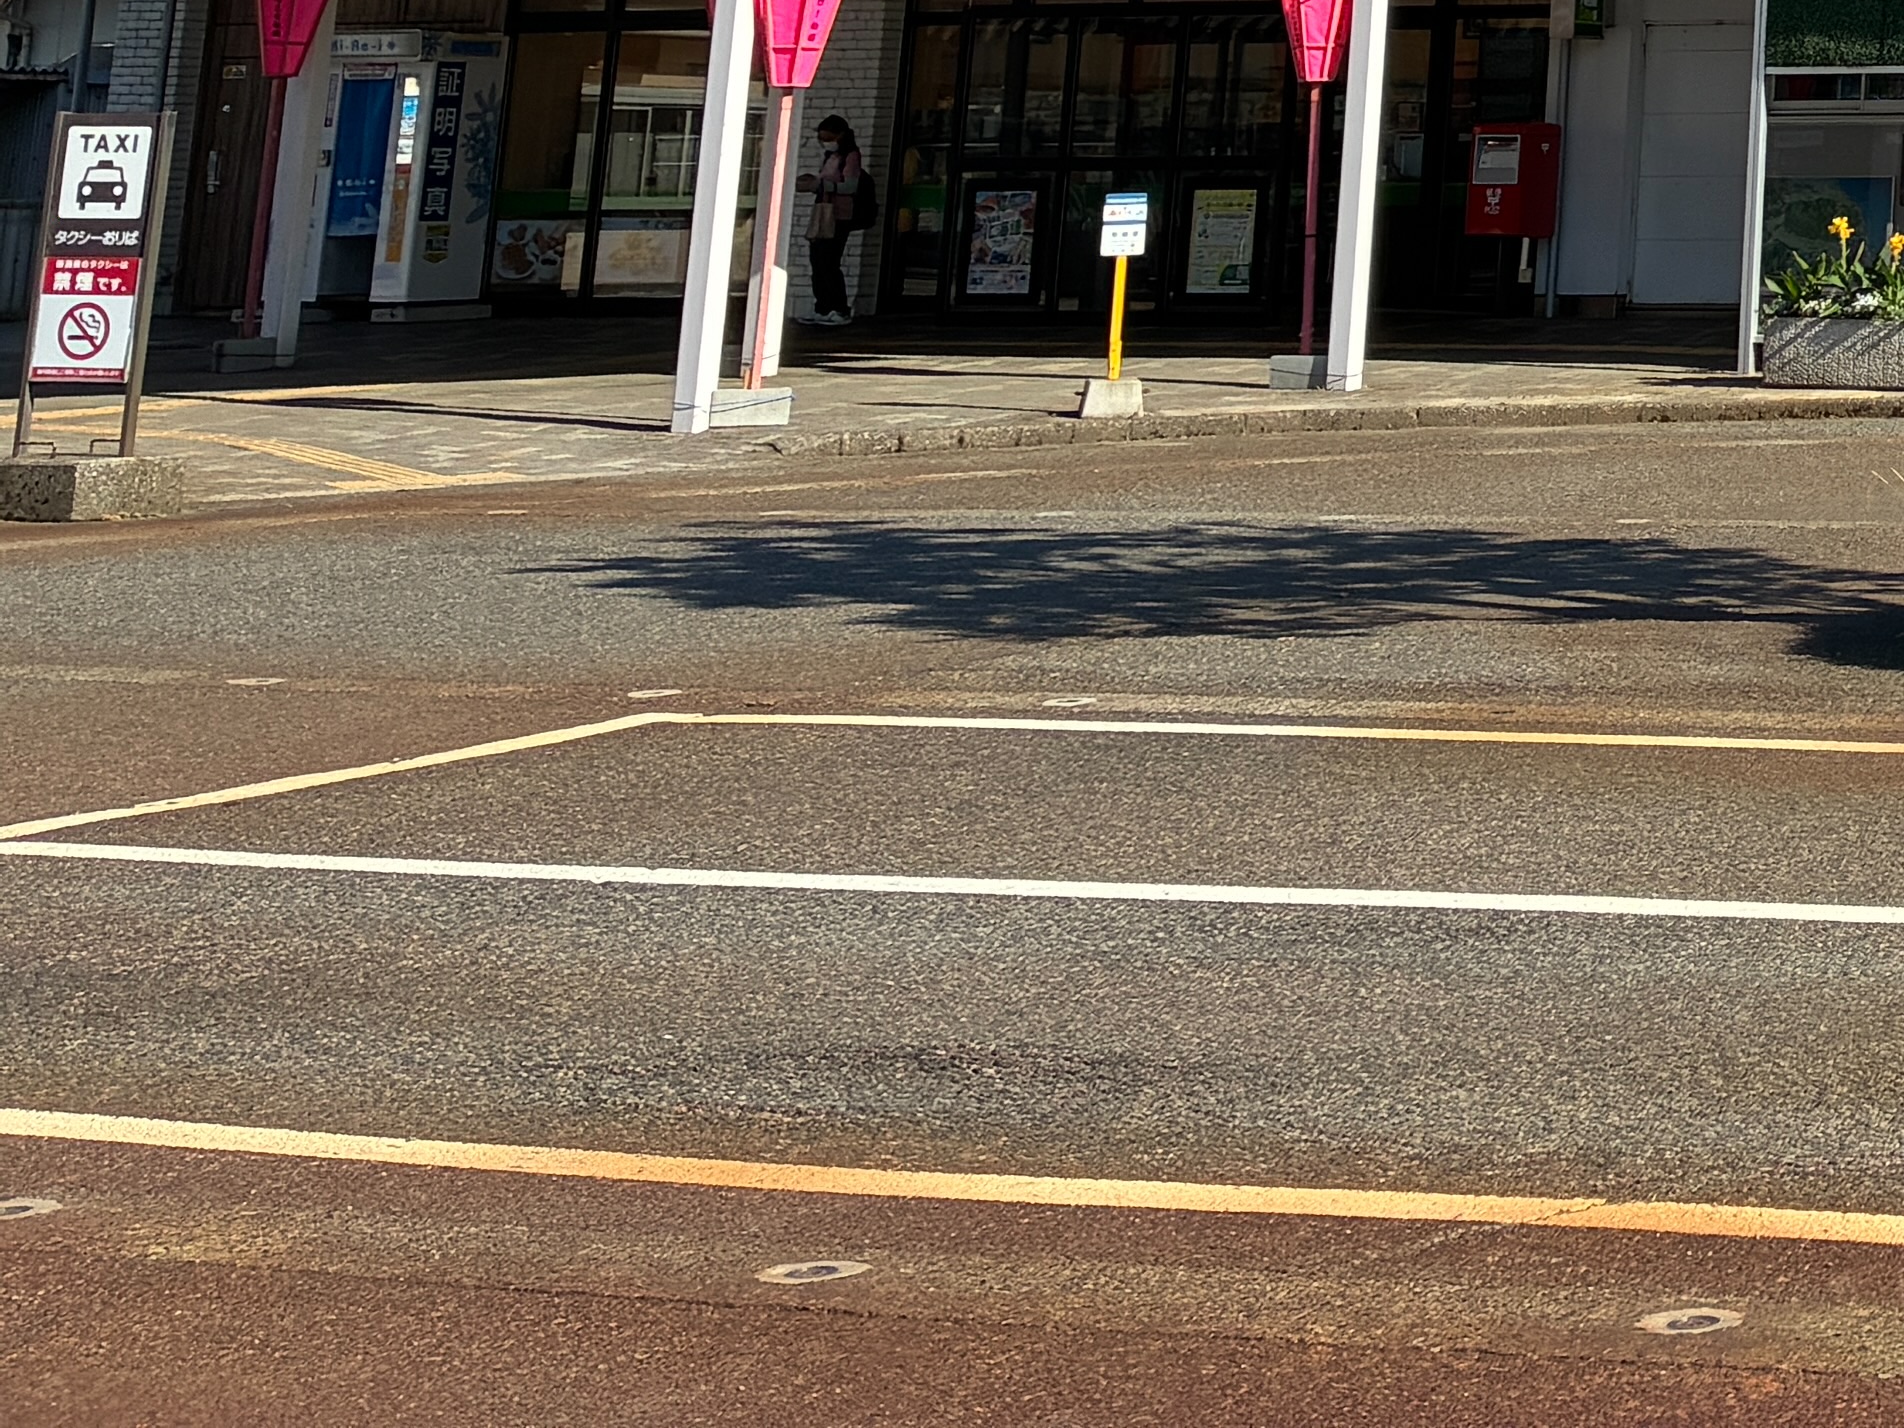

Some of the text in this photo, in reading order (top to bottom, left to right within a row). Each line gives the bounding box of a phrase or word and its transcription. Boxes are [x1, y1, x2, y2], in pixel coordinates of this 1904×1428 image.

[80, 133, 139, 153] TAXI
[424, 67, 460, 216] 証明写真
